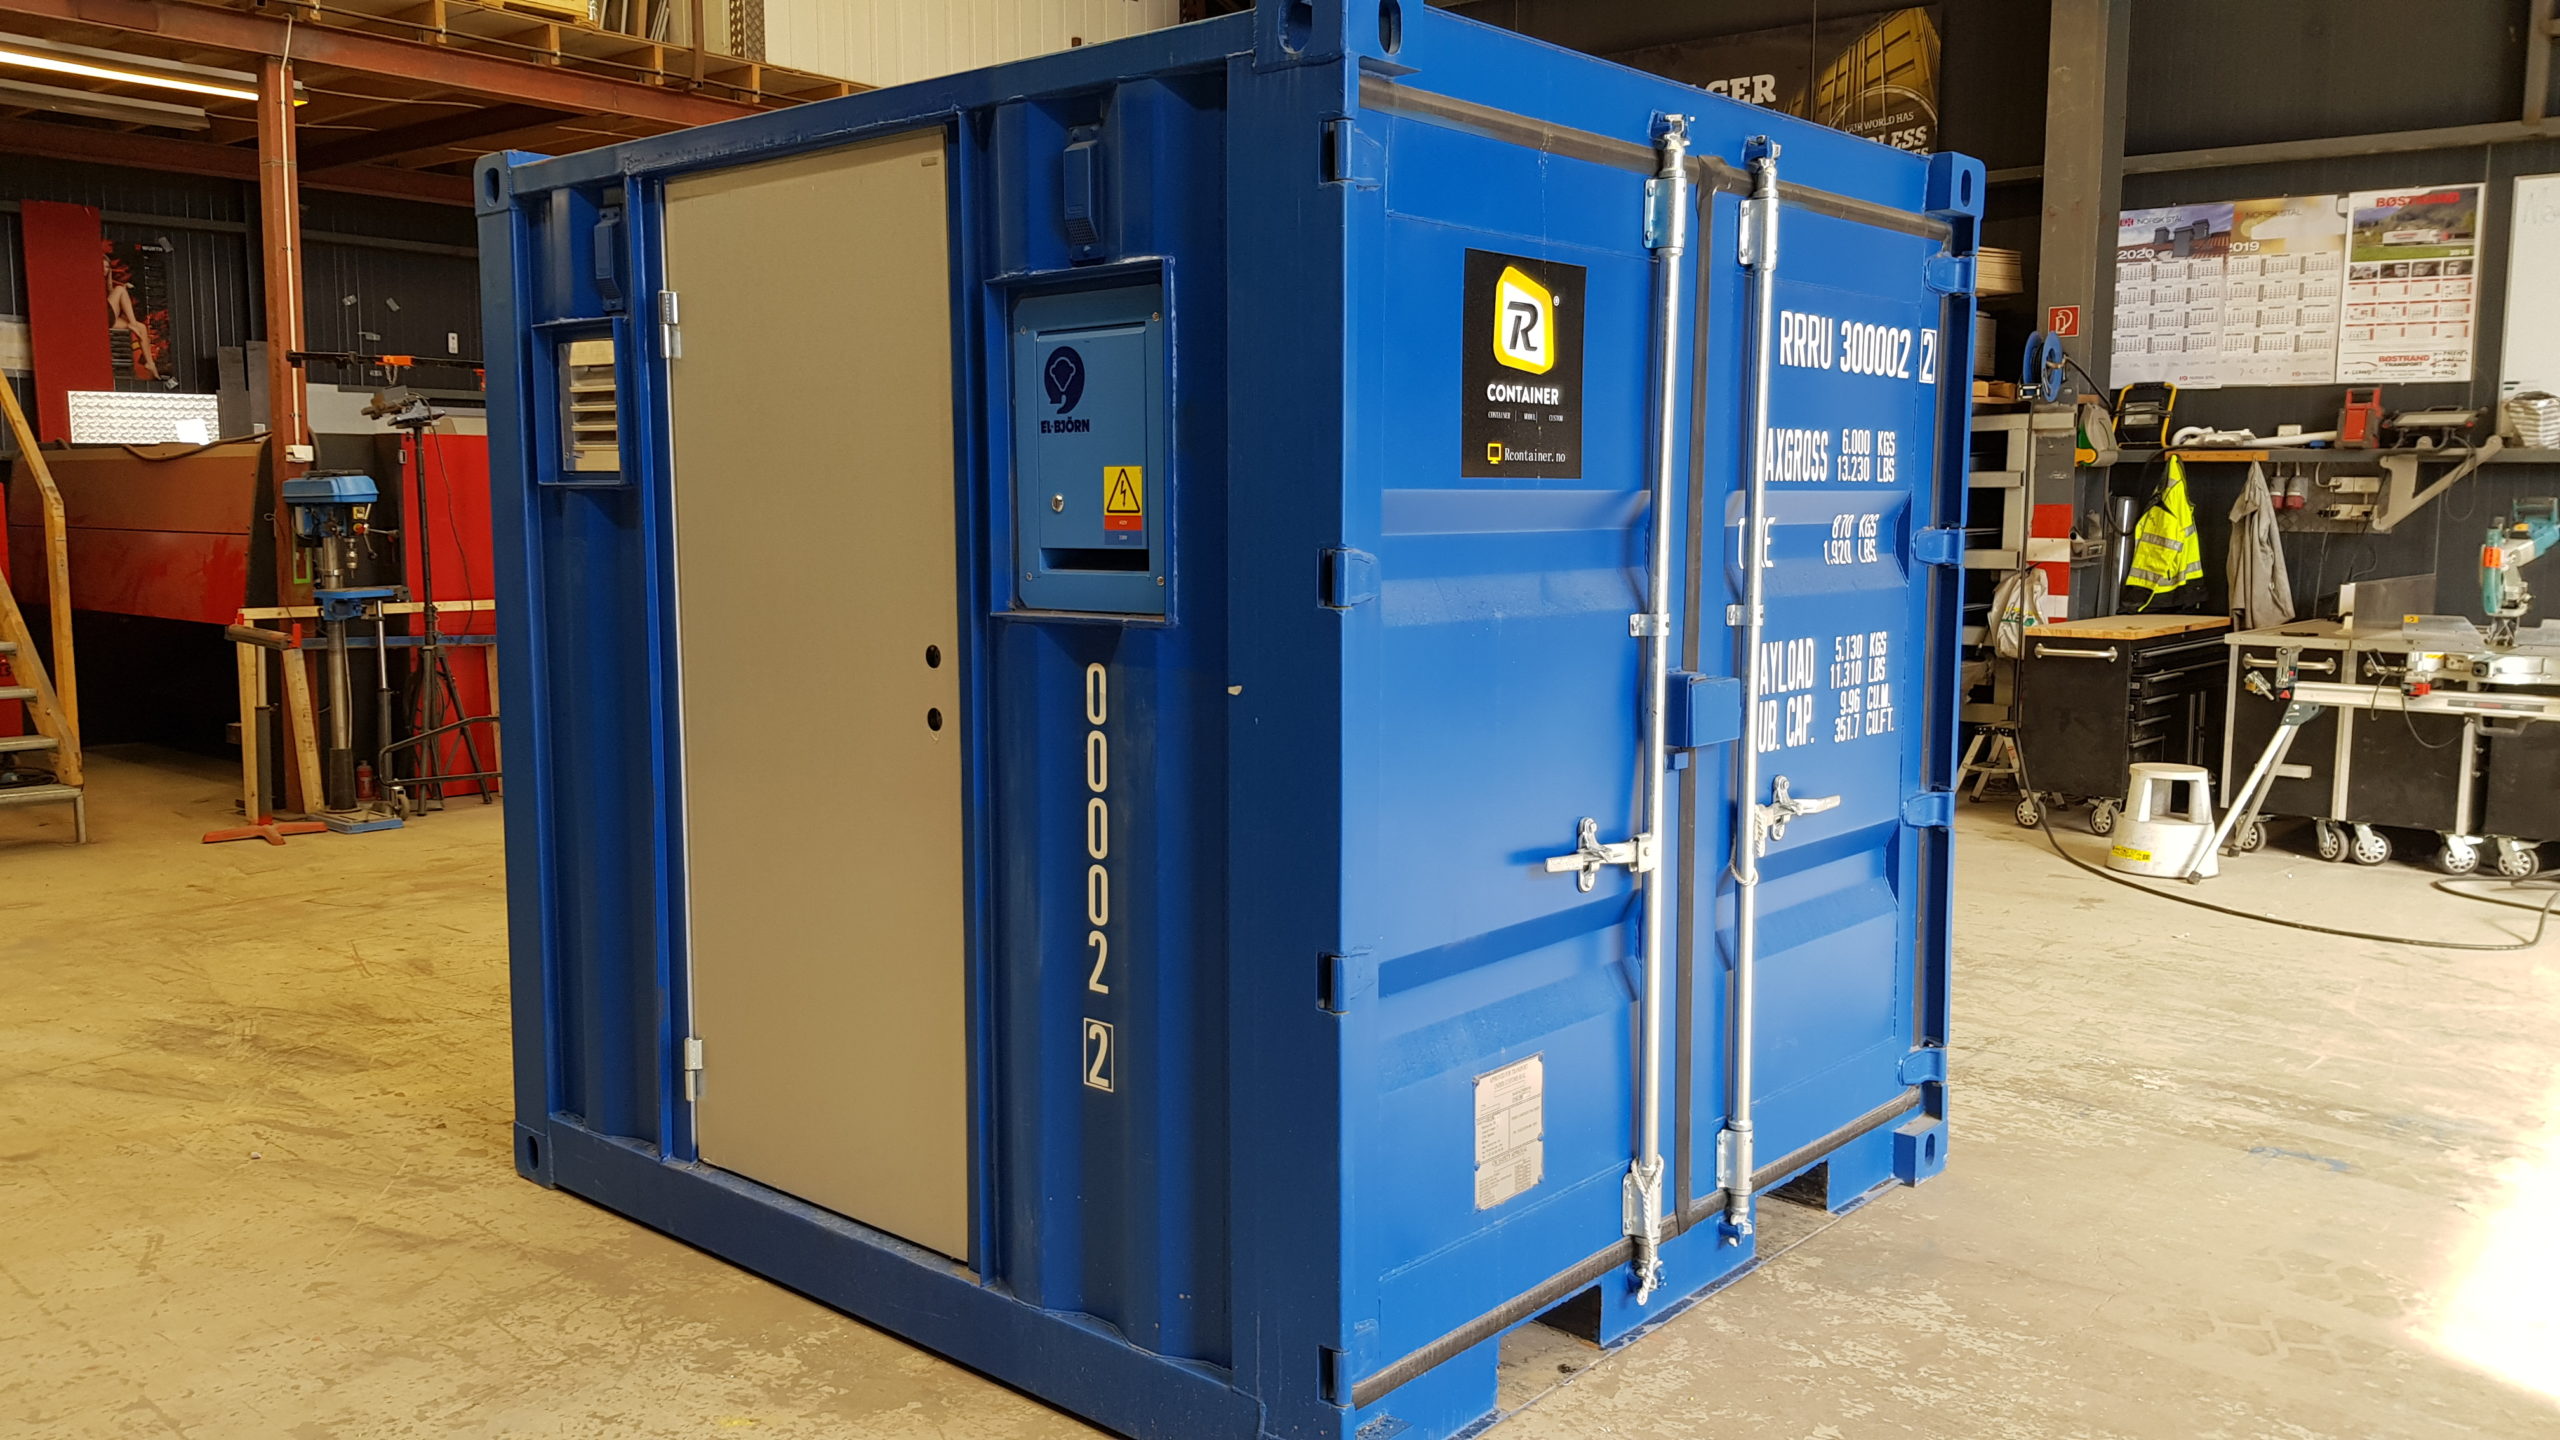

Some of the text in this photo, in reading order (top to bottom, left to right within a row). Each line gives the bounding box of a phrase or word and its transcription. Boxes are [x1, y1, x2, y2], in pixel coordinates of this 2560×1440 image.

[1864, 115, 1895, 130] WORLD
[1896, 111, 1914, 124] HAS
[2117, 248, 2155, 259] 2020
[1779, 310, 1935, 382] RRRU 300002 2
[1486, 383, 1559, 405] CONTAINER
[1504, 447, 1566, 463] Rcontainer.no
[1765, 428, 1896, 482] AXGROSS 6.000 KGS
[1837, 455, 1895, 482] 13.230 LBS
[1831, 514, 1855, 539] 870
[1858, 513, 1880, 538] KGS
[1823, 538, 1878, 565] 1.920 LBS
[1759, 631, 1887, 696] AYLOAD 5.130 KGS
[1830, 656, 1886, 690] 11.310 LBS
[1757, 699, 1780, 753] UB.
[1786, 694, 1815, 748] CAP.
[1839, 688, 1861, 716] 9.96
[1834, 707, 1895, 743] 351.7 CU.FT.
